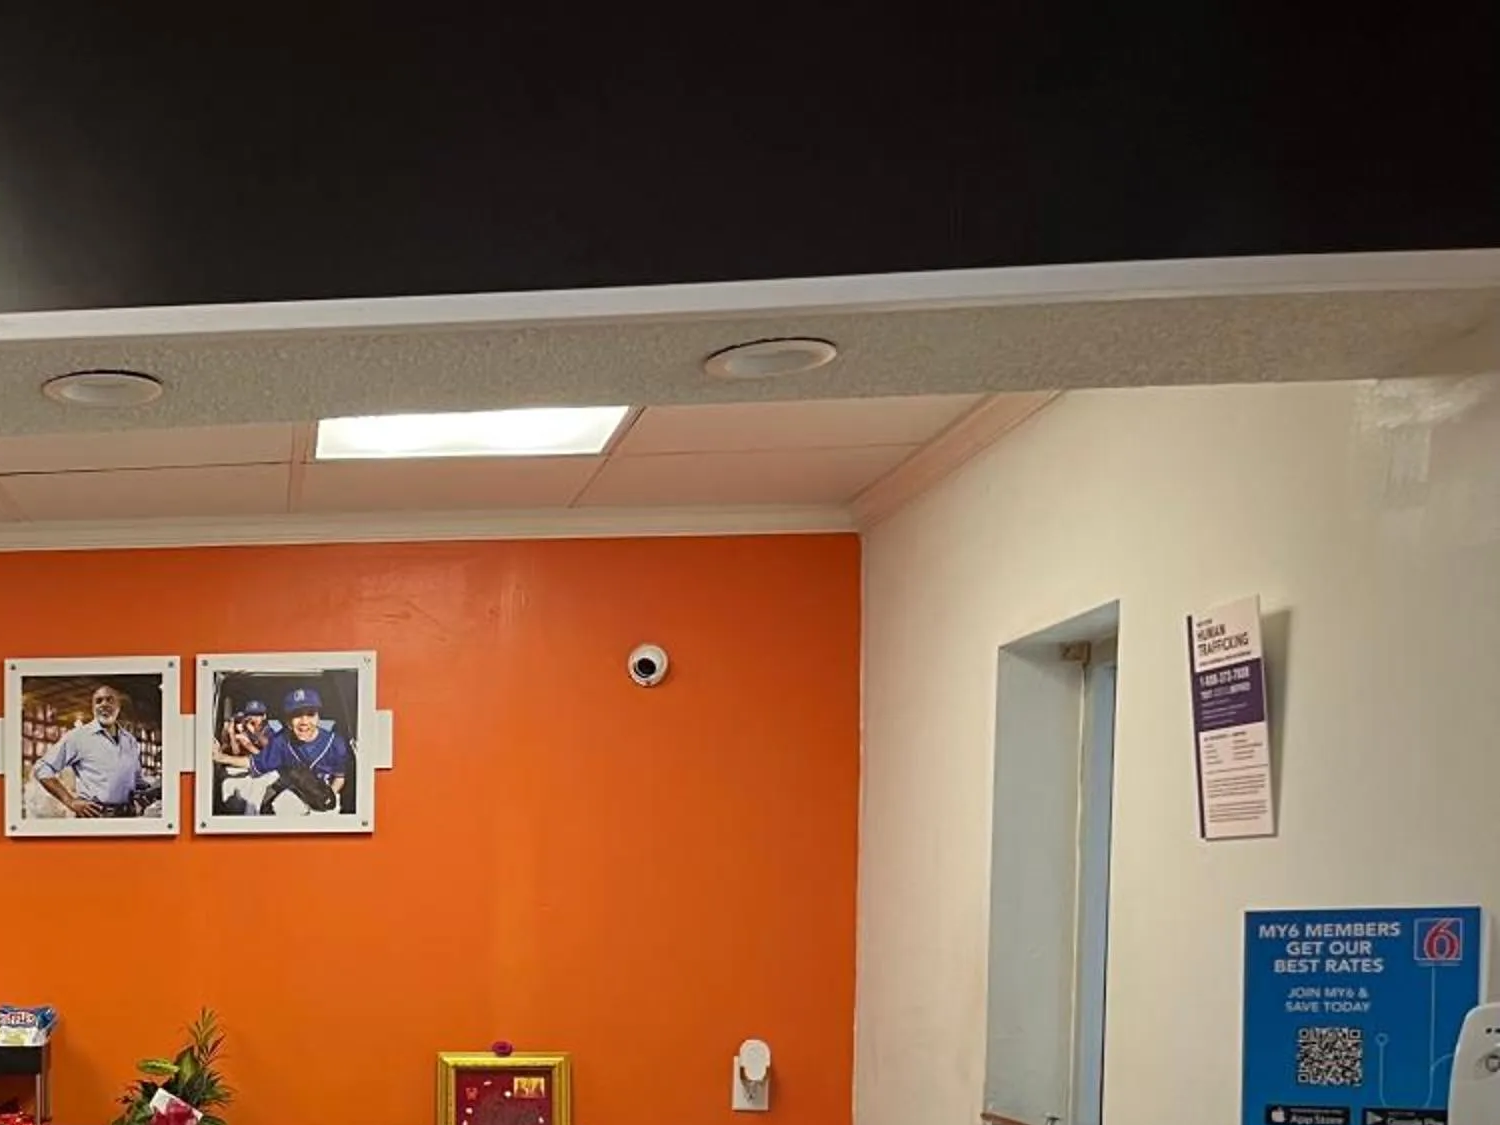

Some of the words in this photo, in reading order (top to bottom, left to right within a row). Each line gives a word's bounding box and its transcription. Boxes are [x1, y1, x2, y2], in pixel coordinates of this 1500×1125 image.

[1258, 924, 1300, 938] MY6
[1305, 922, 1401, 938] MEMBERS
[1423, 918, 1460, 961] 6
[1286, 941, 1324, 956] GET
[1329, 940, 1373, 955] OUR
[1273, 959, 1320, 974] BEST
[1325, 958, 1384, 973] RATES
[1287, 987, 1321, 999] JOIN
[1324, 987, 1353, 998] MY6
[1357, 987, 1369, 998] &
[1284, 1001, 1319, 1012] SAVE
[1323, 1001, 1371, 1013] TODAY
